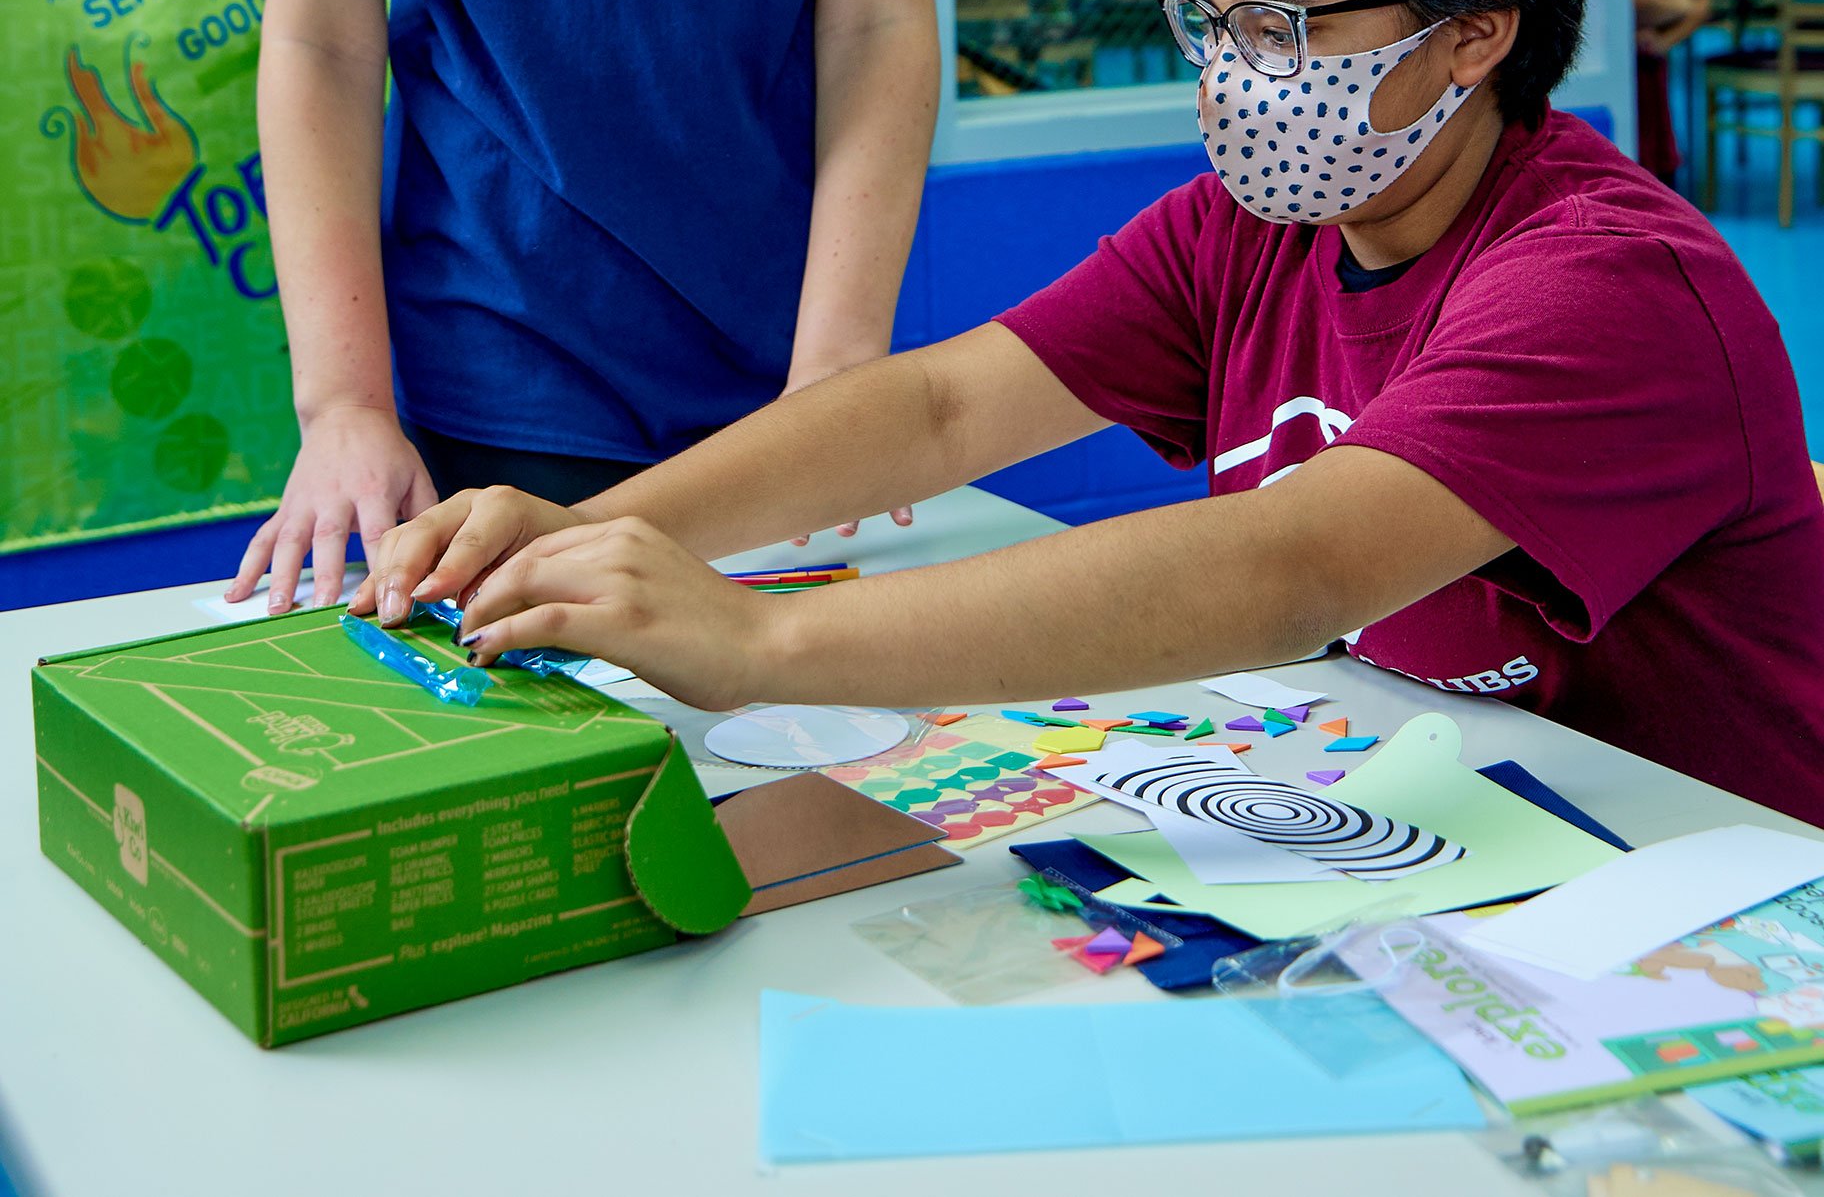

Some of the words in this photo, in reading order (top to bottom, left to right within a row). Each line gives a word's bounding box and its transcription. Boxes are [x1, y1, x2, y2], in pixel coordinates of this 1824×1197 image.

[1407, 655, 1539, 694] UBS
[377, 812, 434, 836] Includes
[437, 796, 510, 820] everything
[513, 790, 537, 809] you
[539, 780, 569, 801] need
[491, 913, 553, 938] Magazine
